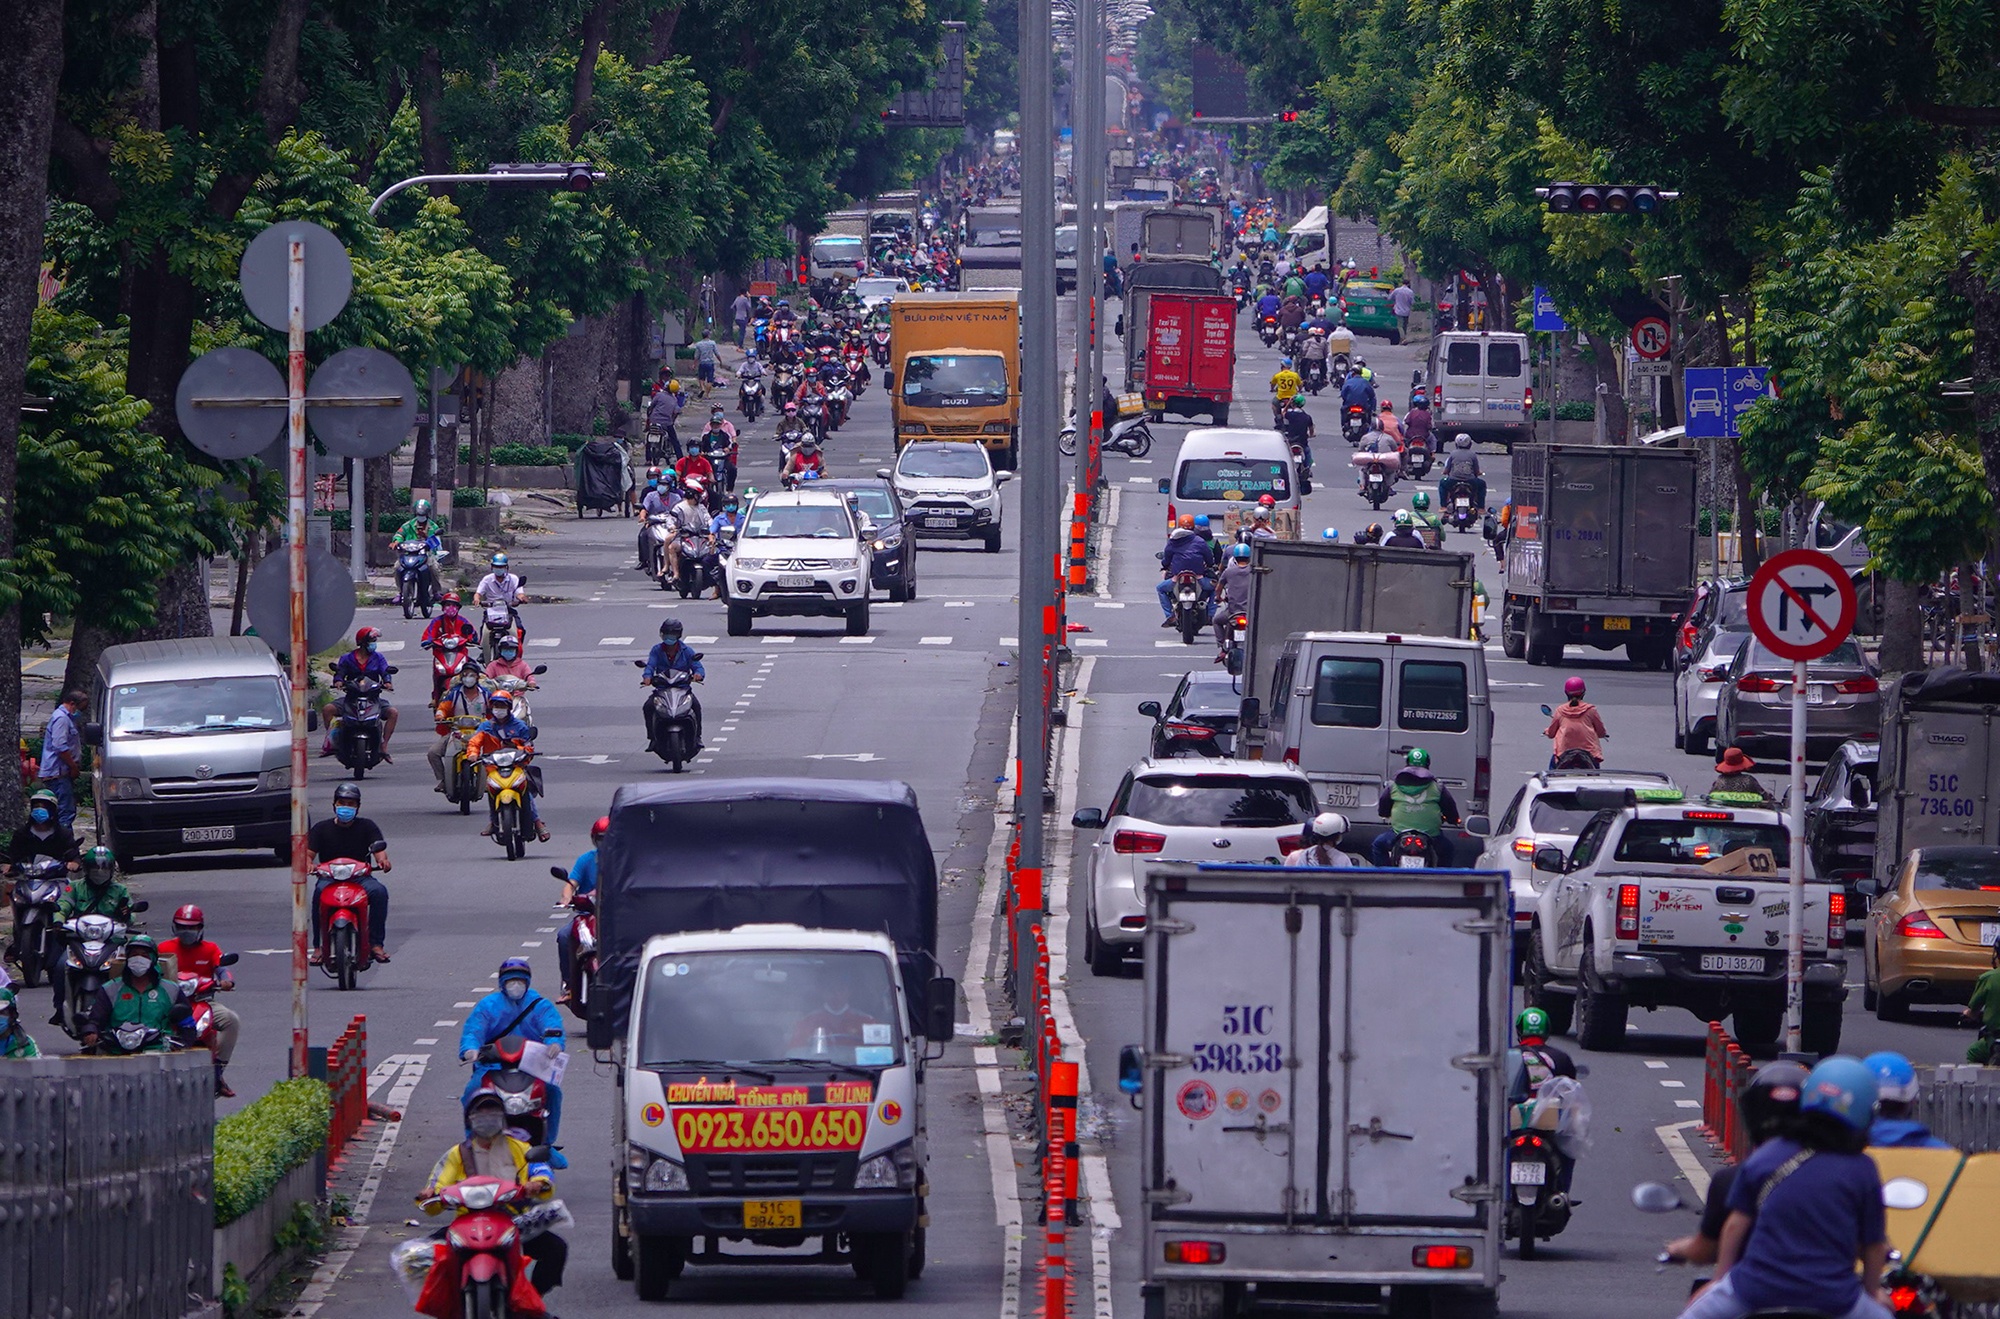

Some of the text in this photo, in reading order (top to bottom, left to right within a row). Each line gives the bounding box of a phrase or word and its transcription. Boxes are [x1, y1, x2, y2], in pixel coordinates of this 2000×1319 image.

[1280, 378, 1294, 389] 39
[1241, 480, 1271, 490] TRANG
[1931, 735, 1965, 743] THACO
[1334, 784, 1352, 795] 51D
[1929, 774, 1959, 793] 51C
[1920, 797, 1974, 817] 736.60
[1222, 1005, 1274, 1036] 51C
[1193, 1043, 1283, 1074] 598.58
[846, 1085, 872, 1103] LINH
[678, 1109, 863, 1149] 0923.650.650
[760, 1202, 784, 1214] 51C
